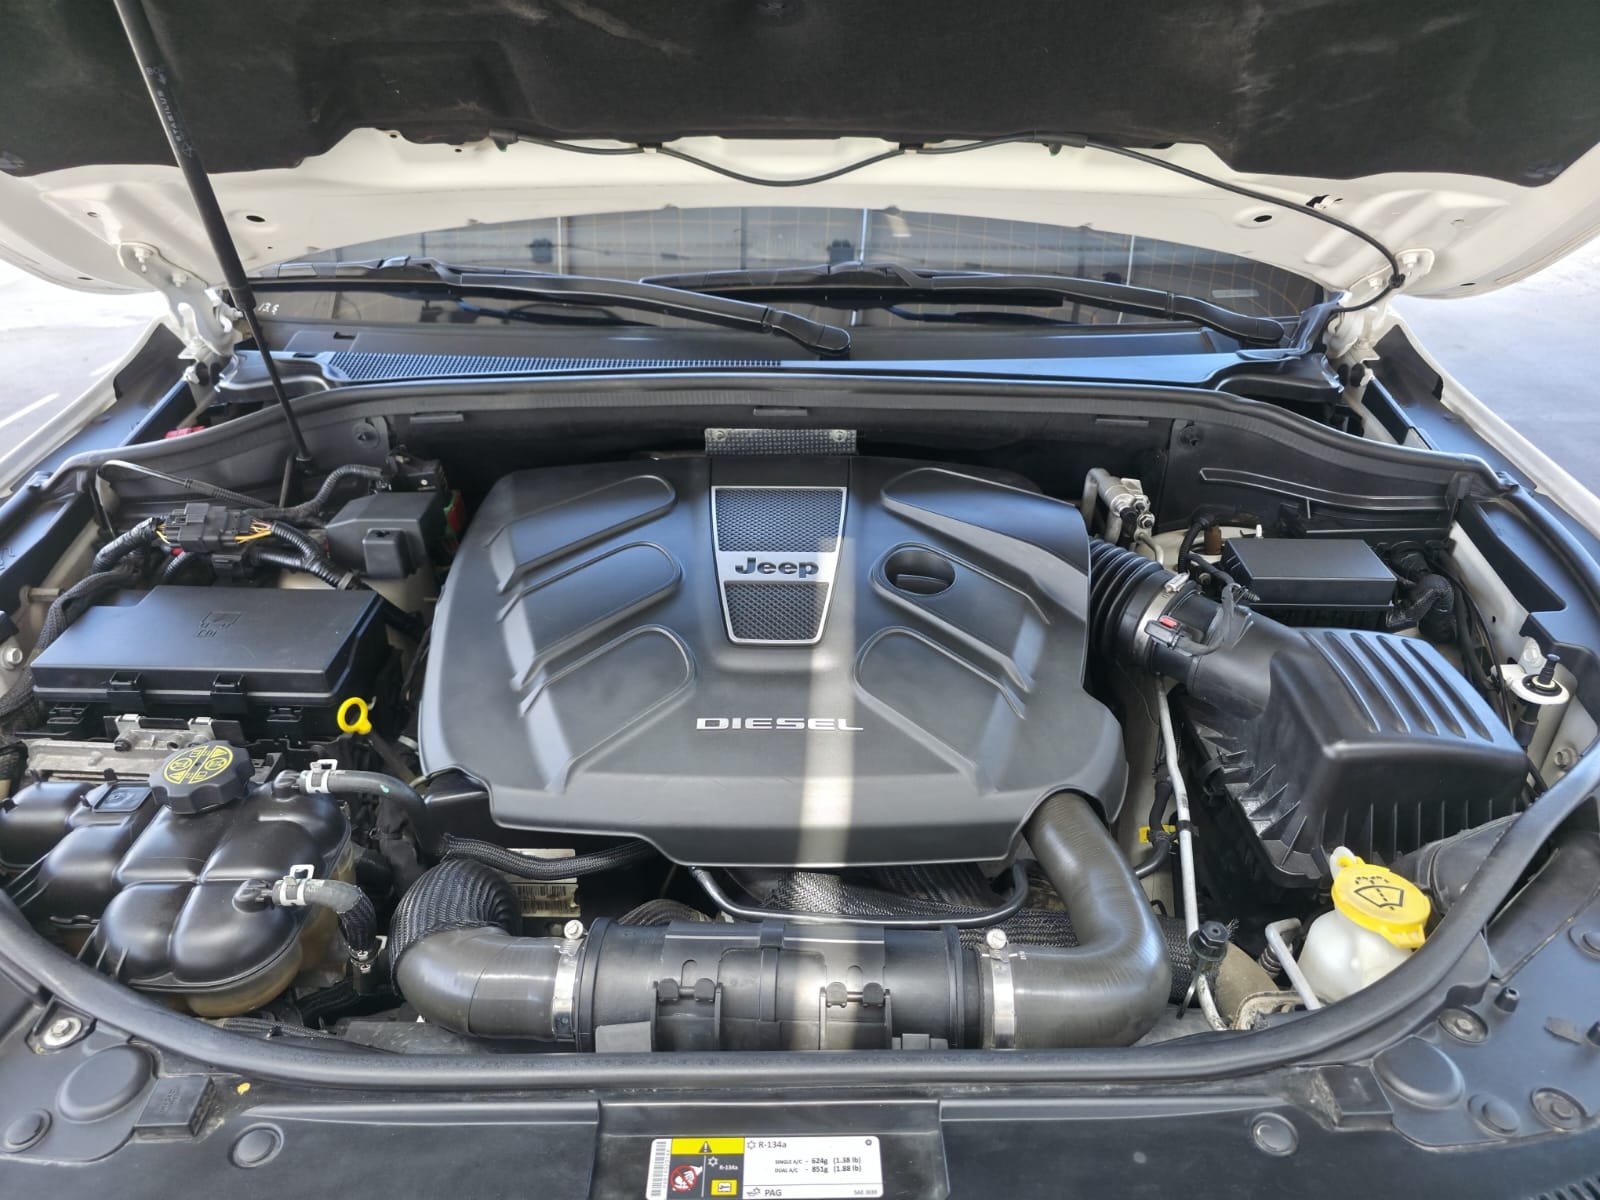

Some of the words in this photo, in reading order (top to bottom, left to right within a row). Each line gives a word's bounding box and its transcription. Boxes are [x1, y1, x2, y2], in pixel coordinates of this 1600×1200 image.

[735, 557, 819, 578] Jeep
[696, 717, 864, 731] DIESEL
[758, 1141, 787, 1149] R-134a
[811, 1157, 828, 1165] 624g
[811, 1166, 828, 1174] 851g
[764, 1188, 782, 1197] PAG
